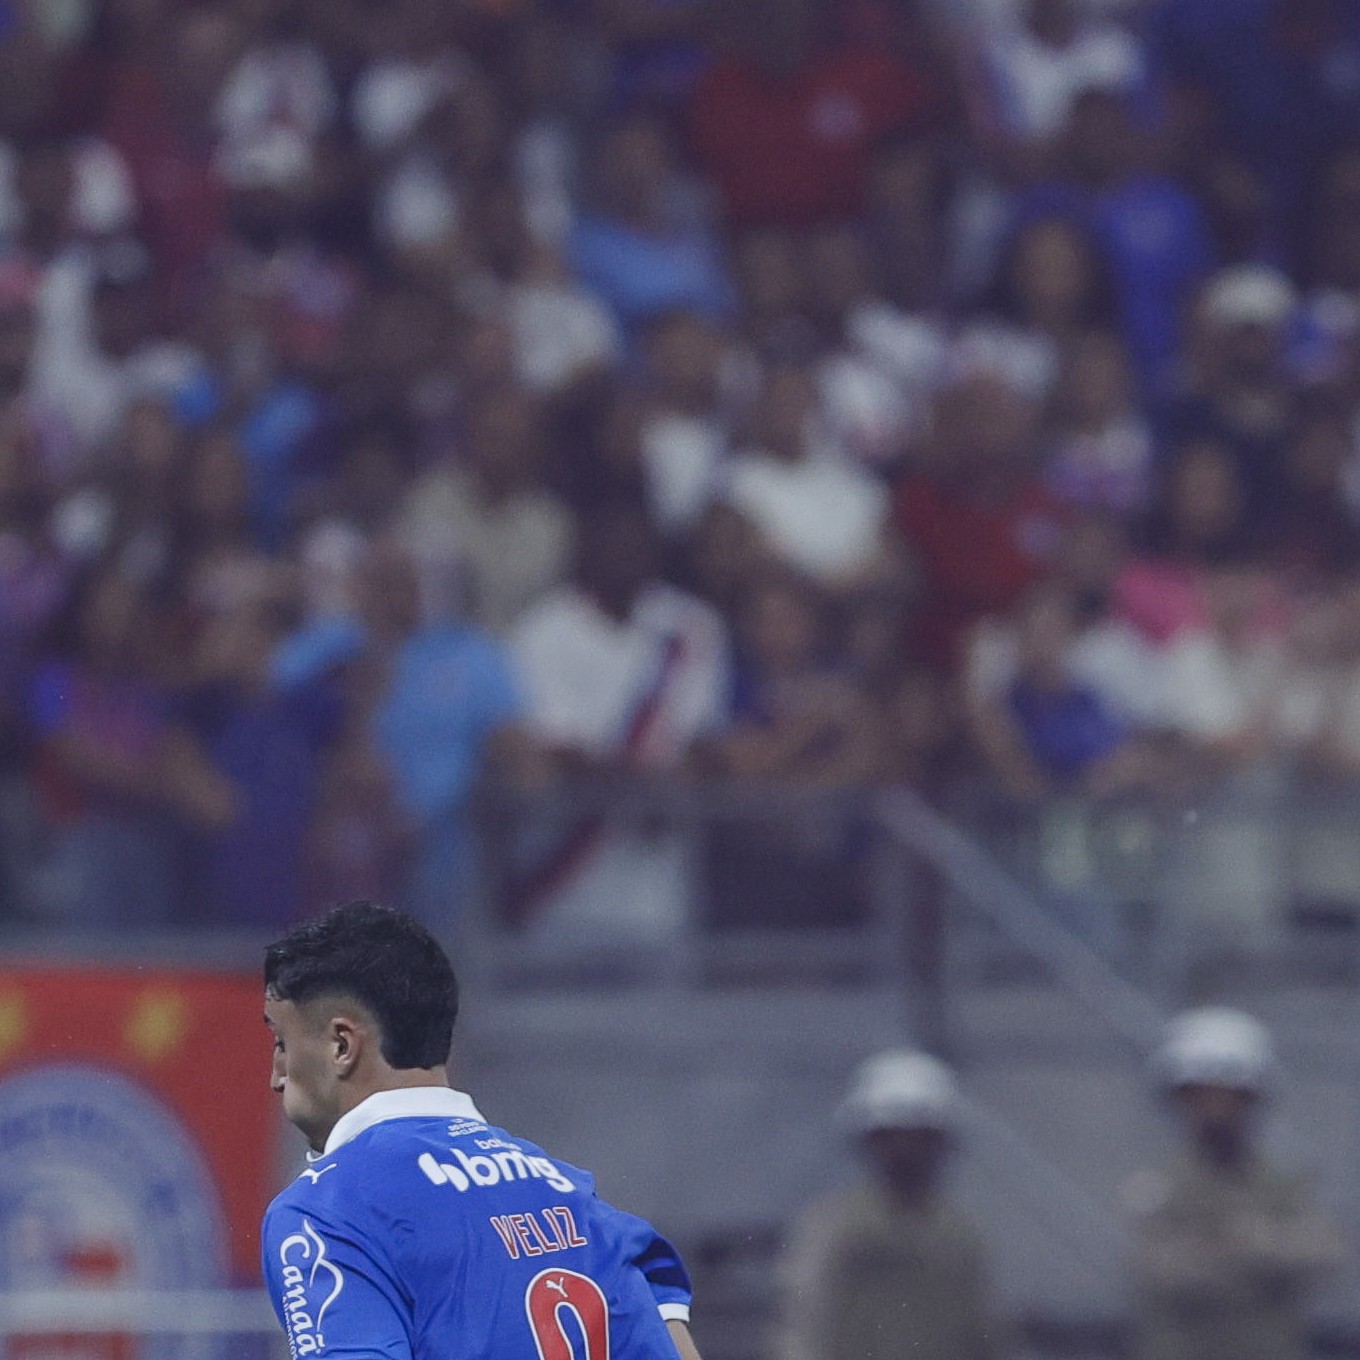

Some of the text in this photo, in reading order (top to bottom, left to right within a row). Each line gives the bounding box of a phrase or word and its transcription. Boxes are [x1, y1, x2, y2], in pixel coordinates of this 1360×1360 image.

[450, 1148, 577, 1193] bmg
[491, 1206, 588, 1260] VELIZ
[280, 1234, 326, 1357] Canaã
